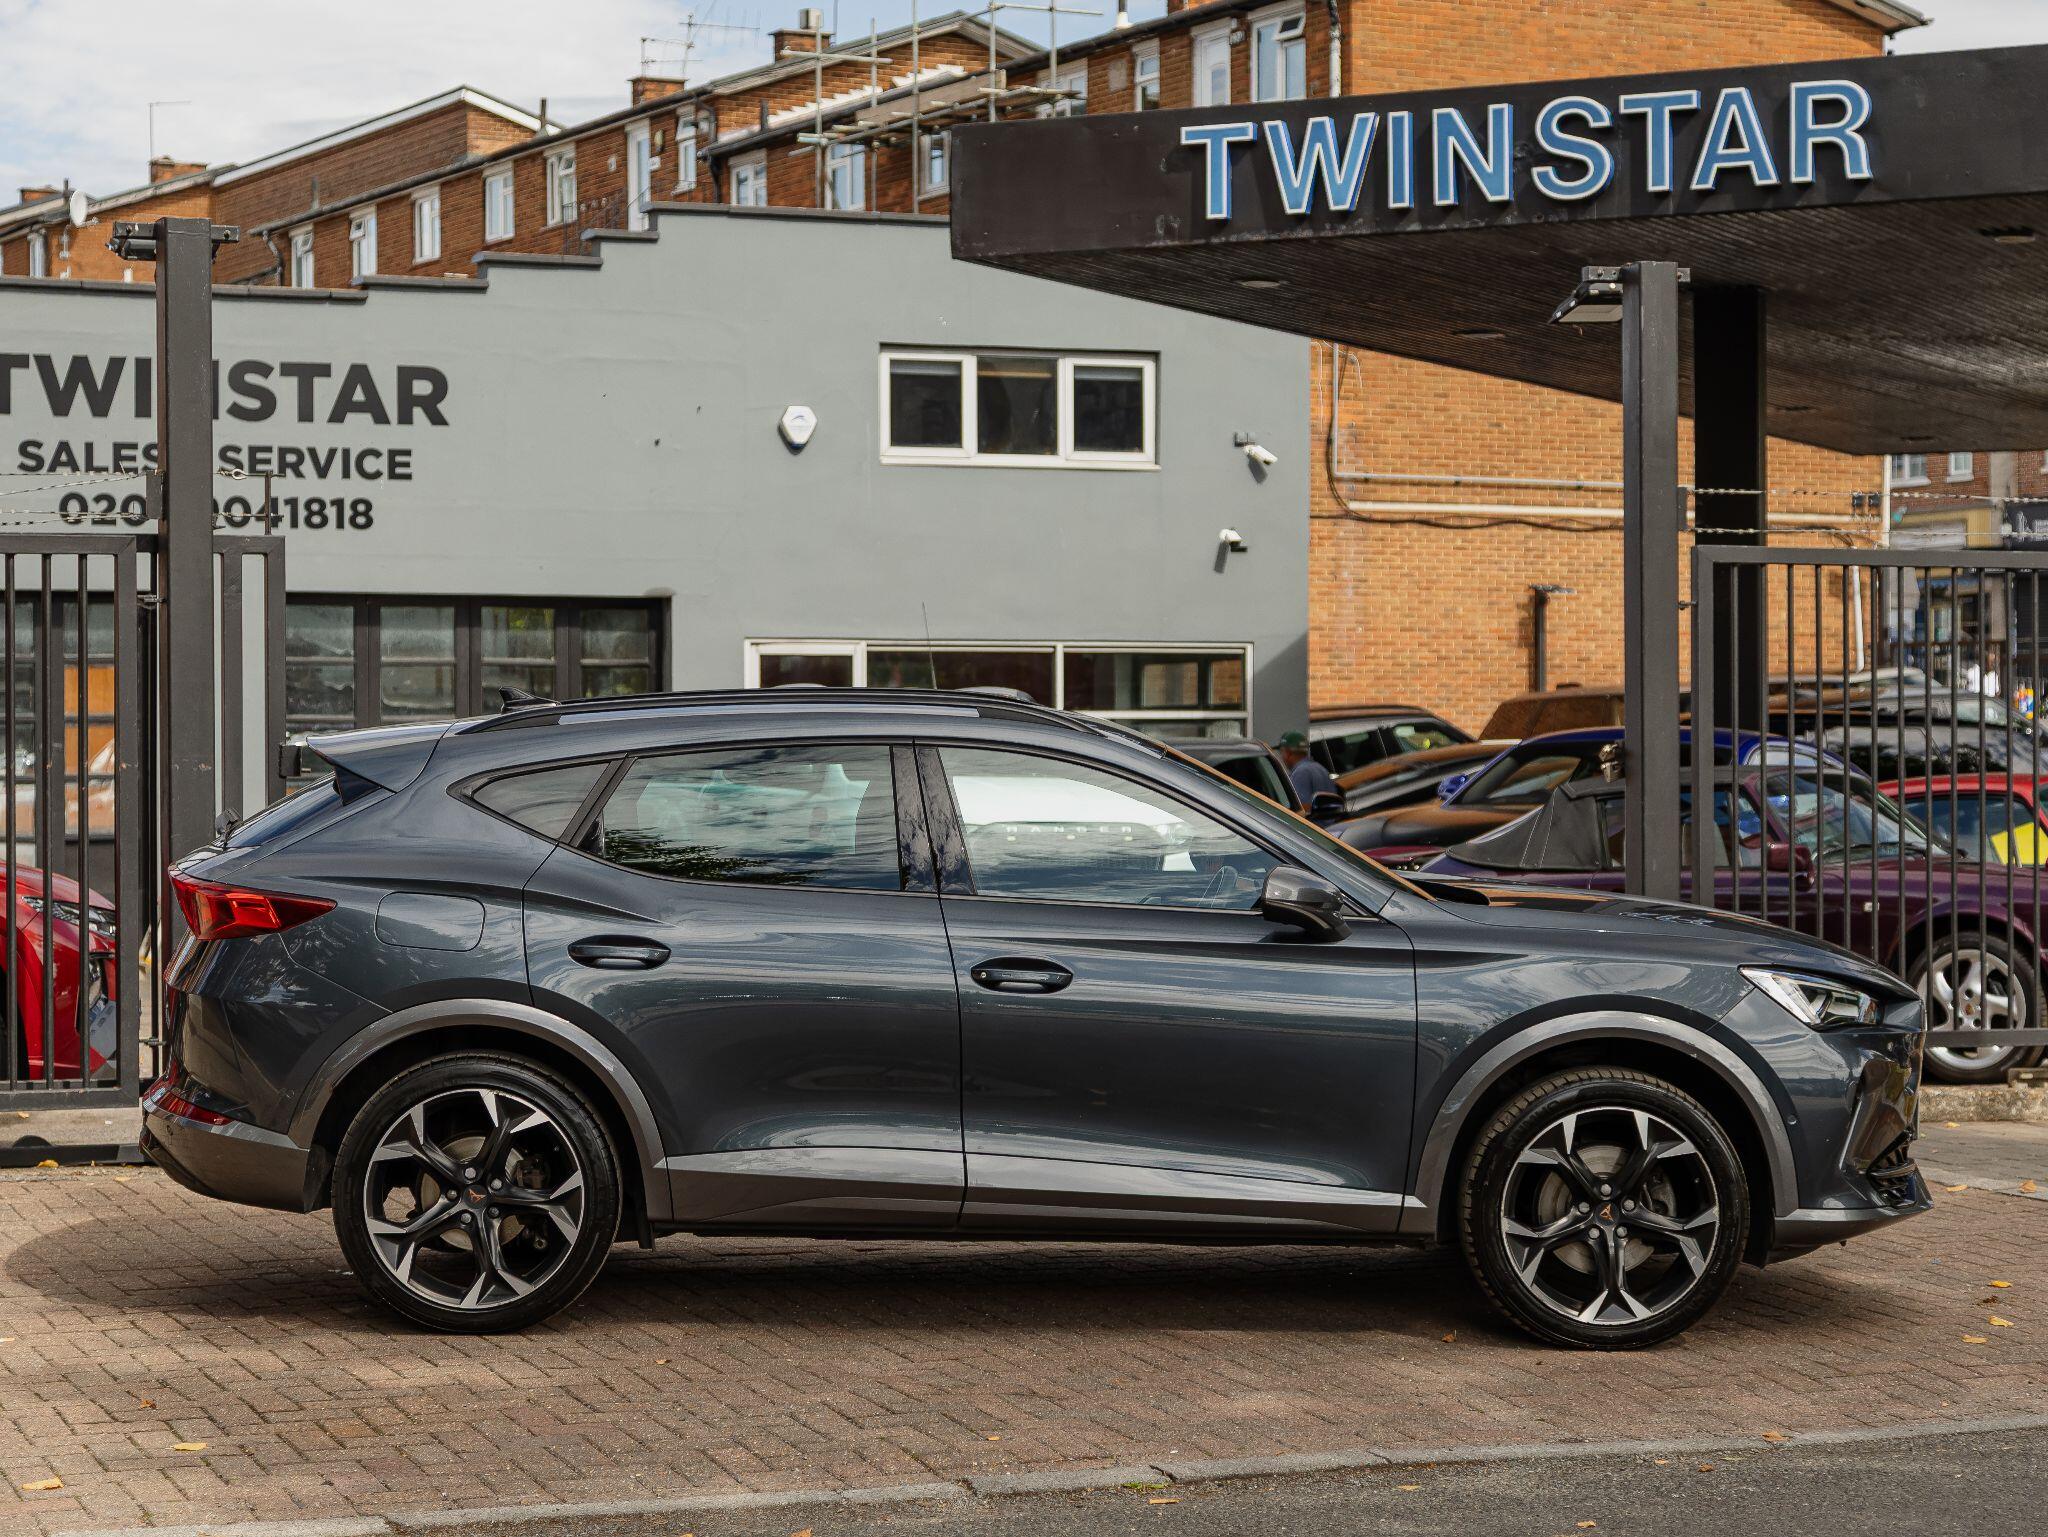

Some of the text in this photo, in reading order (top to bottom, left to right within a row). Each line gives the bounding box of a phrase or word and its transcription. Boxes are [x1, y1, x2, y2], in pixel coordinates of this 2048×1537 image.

[1180, 79, 1873, 220] TWINSTAR
[0, 353, 449, 426] TWISTAR
[217, 445, 413, 480] SERVICE
